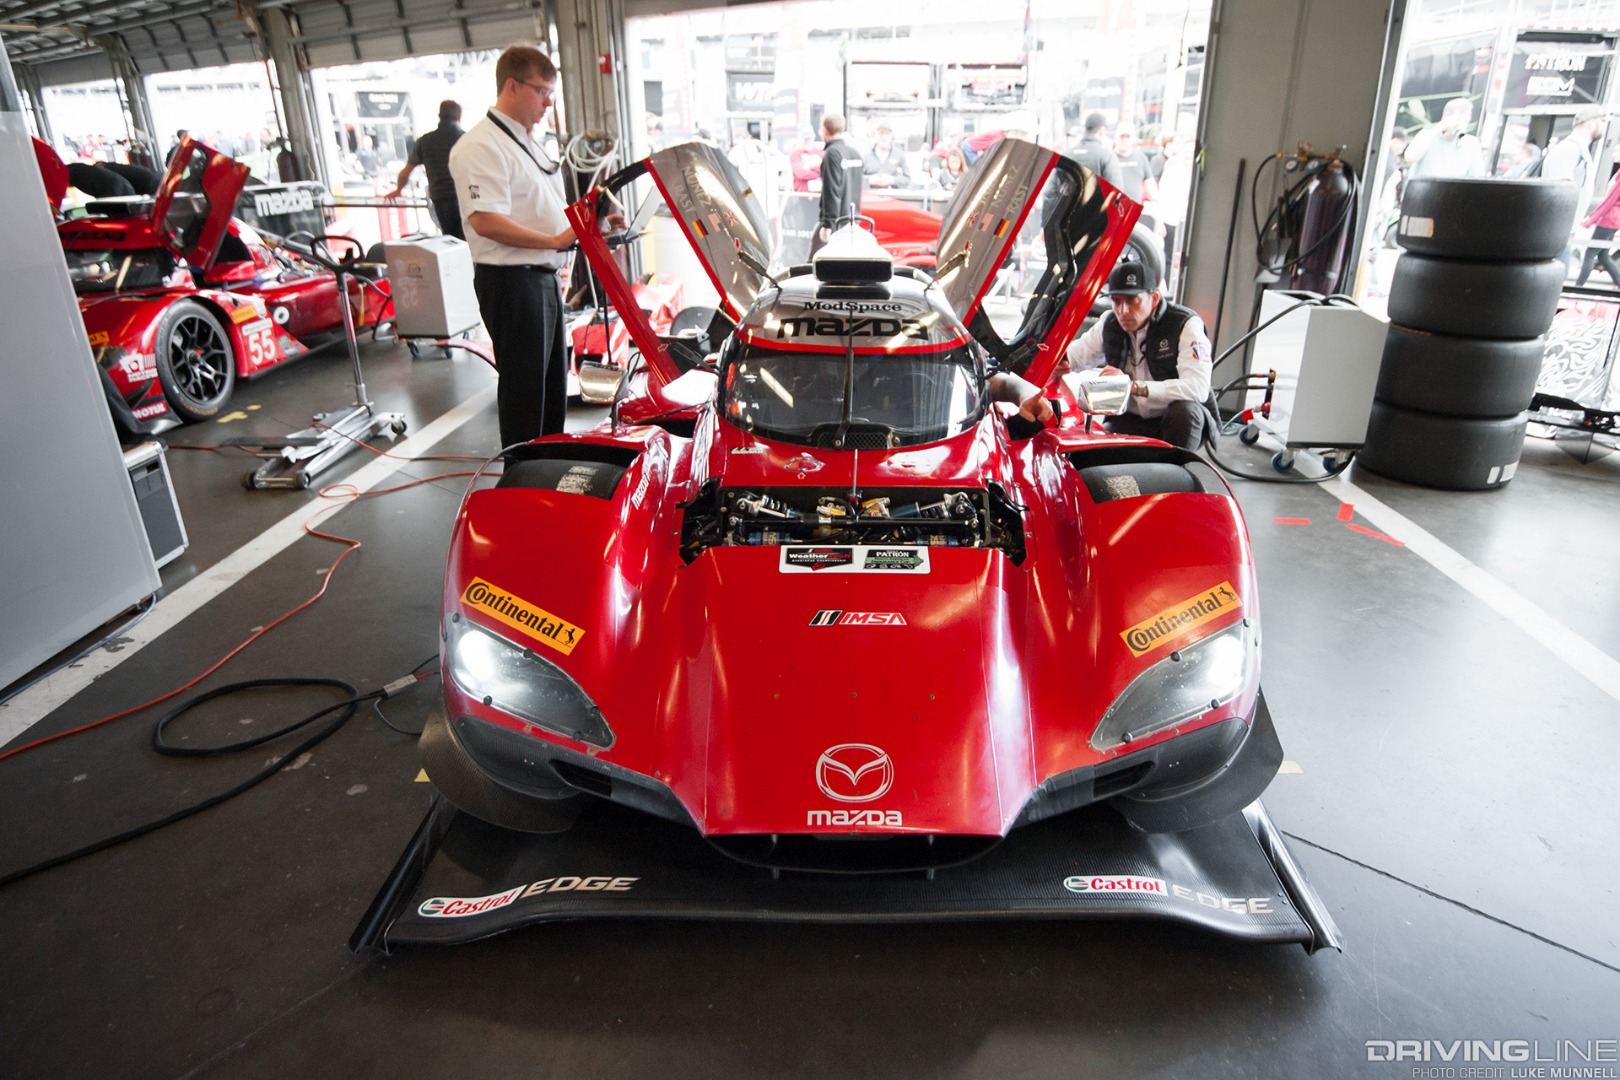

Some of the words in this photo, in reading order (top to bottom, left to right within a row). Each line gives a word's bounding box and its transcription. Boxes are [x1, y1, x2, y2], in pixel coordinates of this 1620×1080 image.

[1005, 184, 1029, 214] RAST
[803, 301, 902, 313] ModSpace
[249, 329, 276, 365] 55
[131, 402, 166, 419] MOTUL
[466, 582, 565, 640] Continental
[839, 612, 907, 625] IMSA
[1127, 592, 1223, 652] Continental
[442, 889, 518, 915] Castrol
[519, 876, 641, 899] EDGE
[1091, 877, 1162, 892] Castrol
[1172, 884, 1275, 914] EDGE
